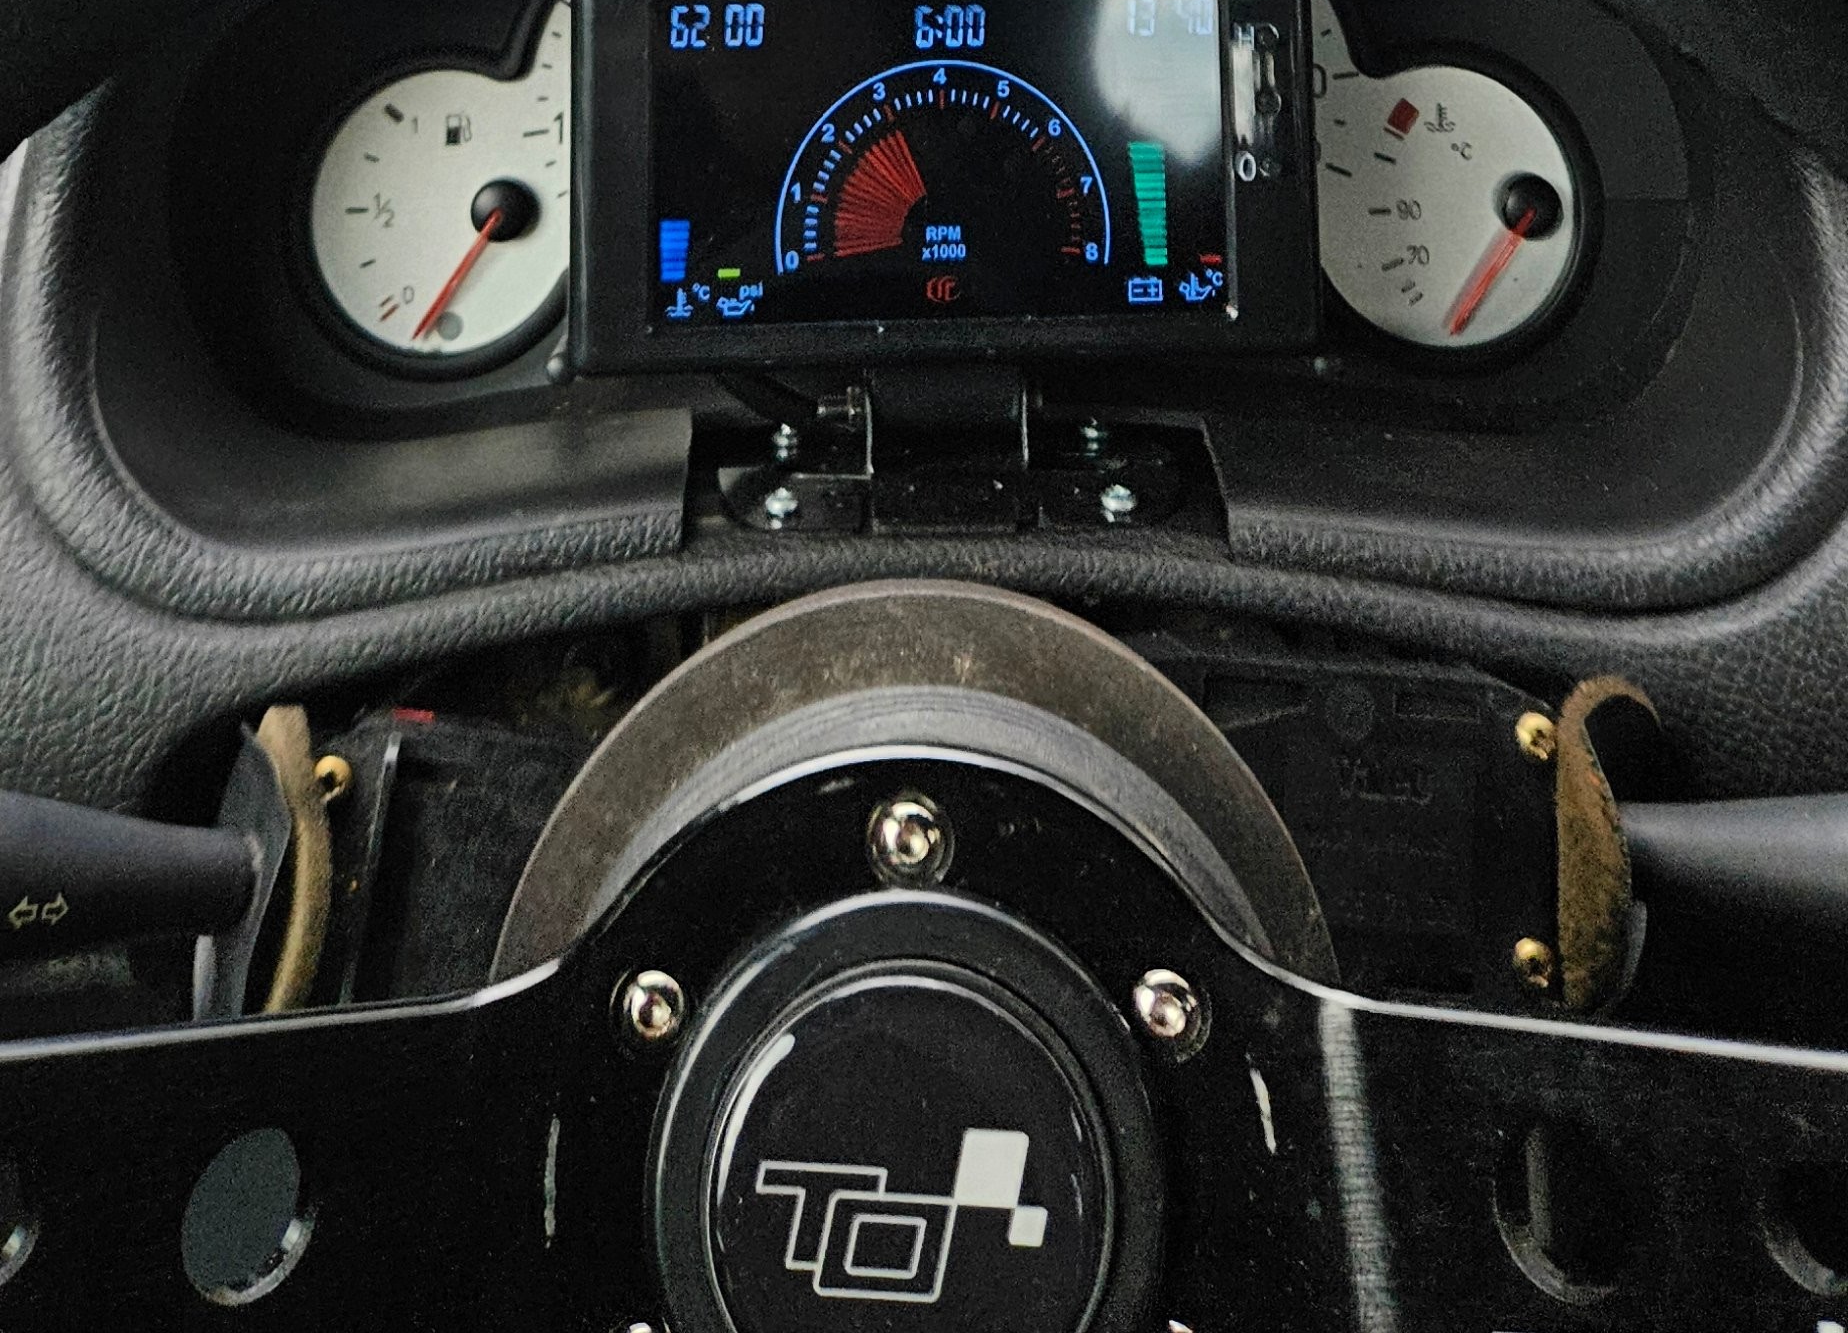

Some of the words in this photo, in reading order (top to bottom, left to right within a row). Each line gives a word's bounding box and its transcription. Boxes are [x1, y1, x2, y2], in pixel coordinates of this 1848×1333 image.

[914, 4, 986, 48] 6:00
[932, 67, 947, 84] 4
[872, 81, 886, 101] 3
[997, 80, 1010, 98] 5
[821, 123, 836, 143] 2
[1047, 118, 1061, 136] 6
[790, 182, 801, 203] 1
[1080, 176, 1092, 197] 7
[925, 225, 961, 243] RPM
[785, 250, 800, 270] 0
[922, 243, 966, 261] x1000
[1084, 242, 1099, 262] 8
[739, 281, 763, 301] psi
